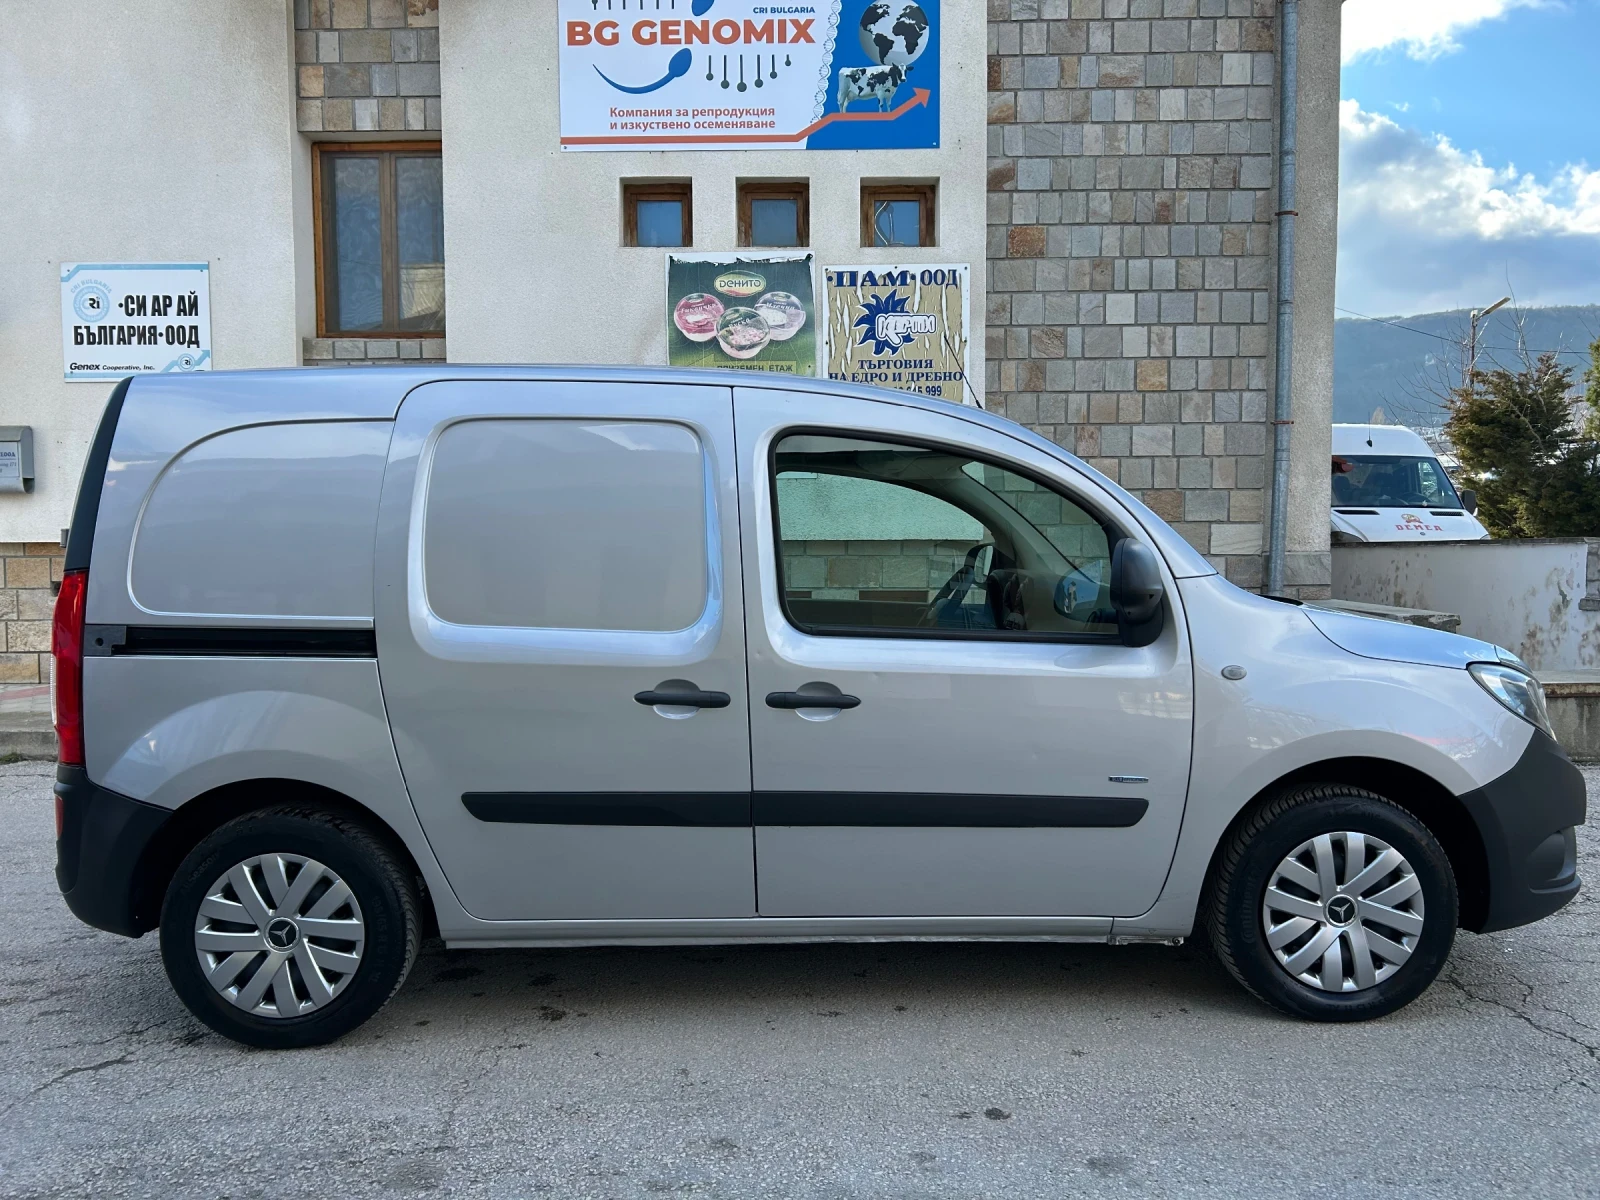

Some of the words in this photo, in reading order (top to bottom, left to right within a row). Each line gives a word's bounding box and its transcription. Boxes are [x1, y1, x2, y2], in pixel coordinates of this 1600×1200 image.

[770, 6, 815, 14] BULGARIA
[566, 20, 620, 46] BG
[631, 18, 816, 46] GENOMIX
[609, 107, 673, 119] Компания
[675, 108, 689, 117] за
[691, 107, 775, 121] репродукция
[609, 121, 618, 130] и
[620, 120, 691, 131] изкуствено
[693, 119, 776, 130] осеменяване
[150, 295, 172, 317] АР
[176, 290, 199, 317] АЙ
[69, 362, 101, 371] Genex
[768, 364, 794, 372] ЕТАЖ
[858, 359, 934, 370] ТЪРГОВИЯ
[851, 372, 889, 383] ЕДРО
[892, 372, 902, 381] И
[905, 371, 963, 383] ДРЕБНО
[925, 385, 942, 397] 999
